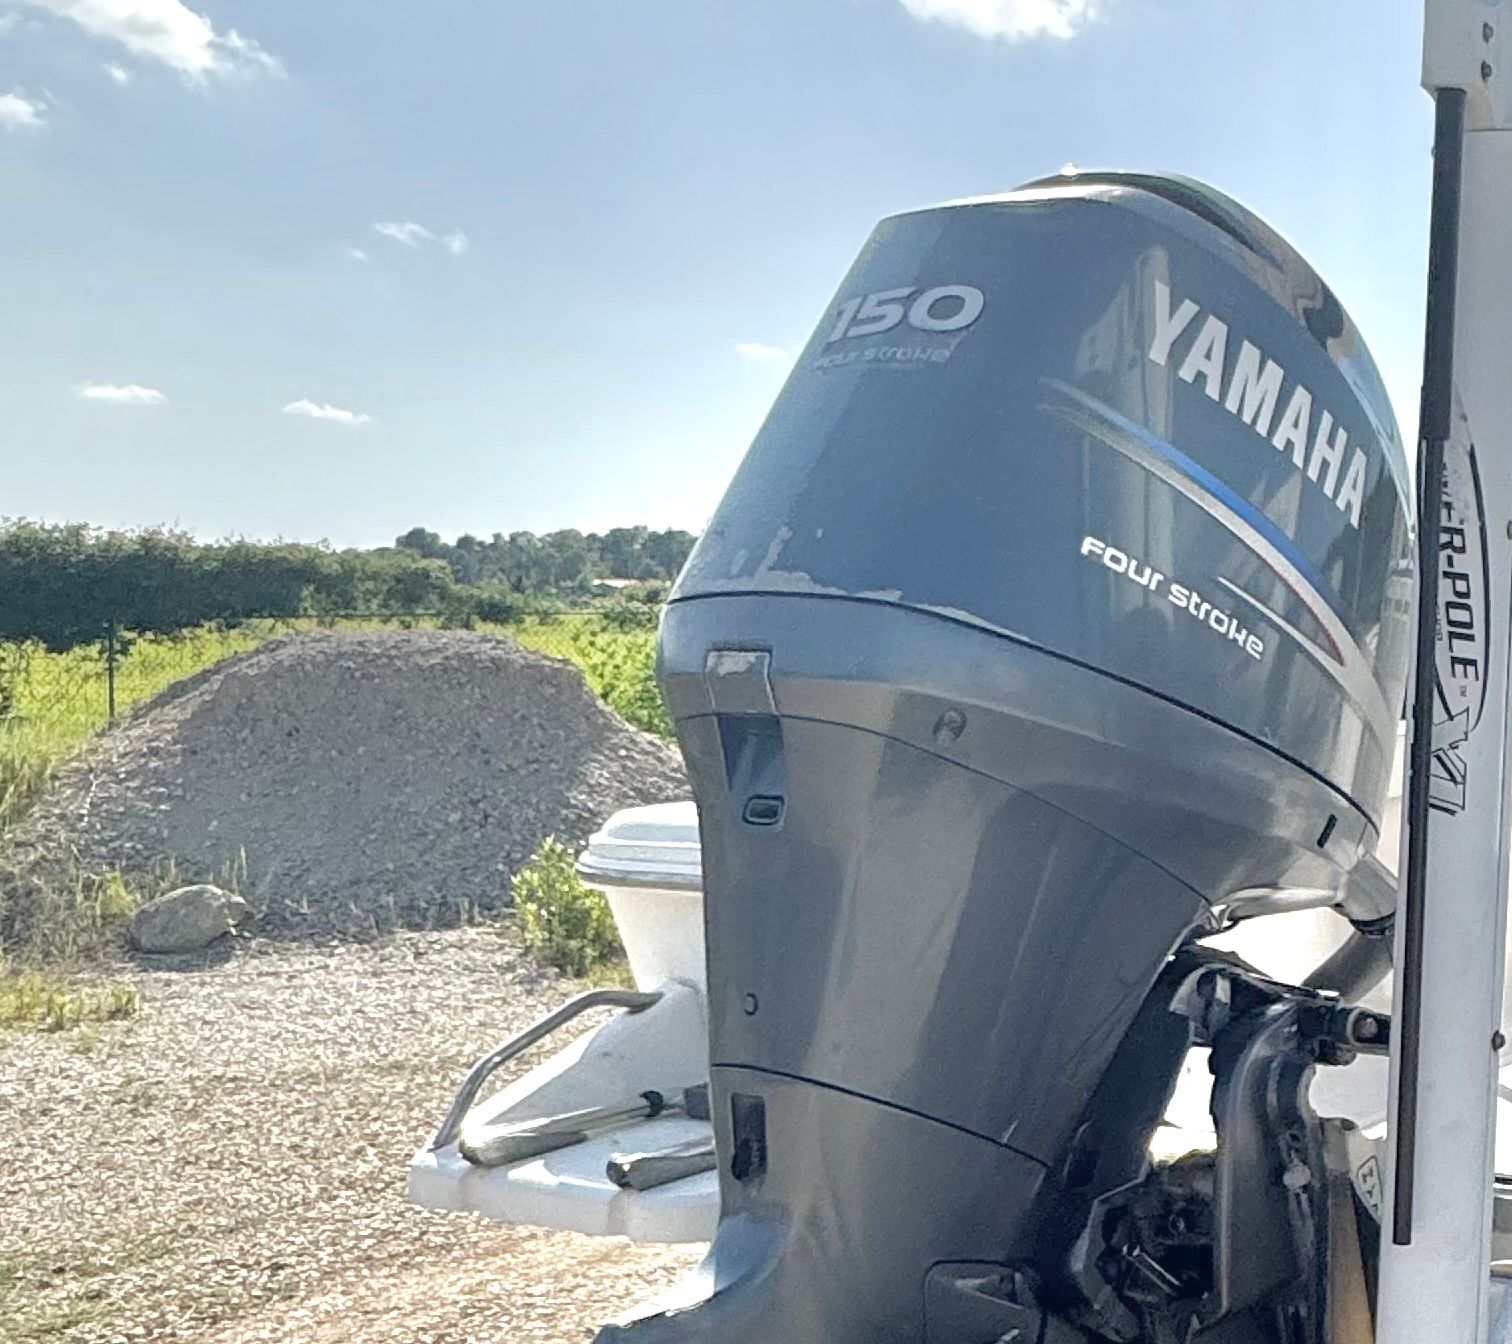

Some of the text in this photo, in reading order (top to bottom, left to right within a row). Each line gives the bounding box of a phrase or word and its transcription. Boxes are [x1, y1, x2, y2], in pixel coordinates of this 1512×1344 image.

[827, 284, 985, 346] 150
[1149, 280, 1367, 529] YAMAHA
[1080, 536, 1264, 660] Four stroke
